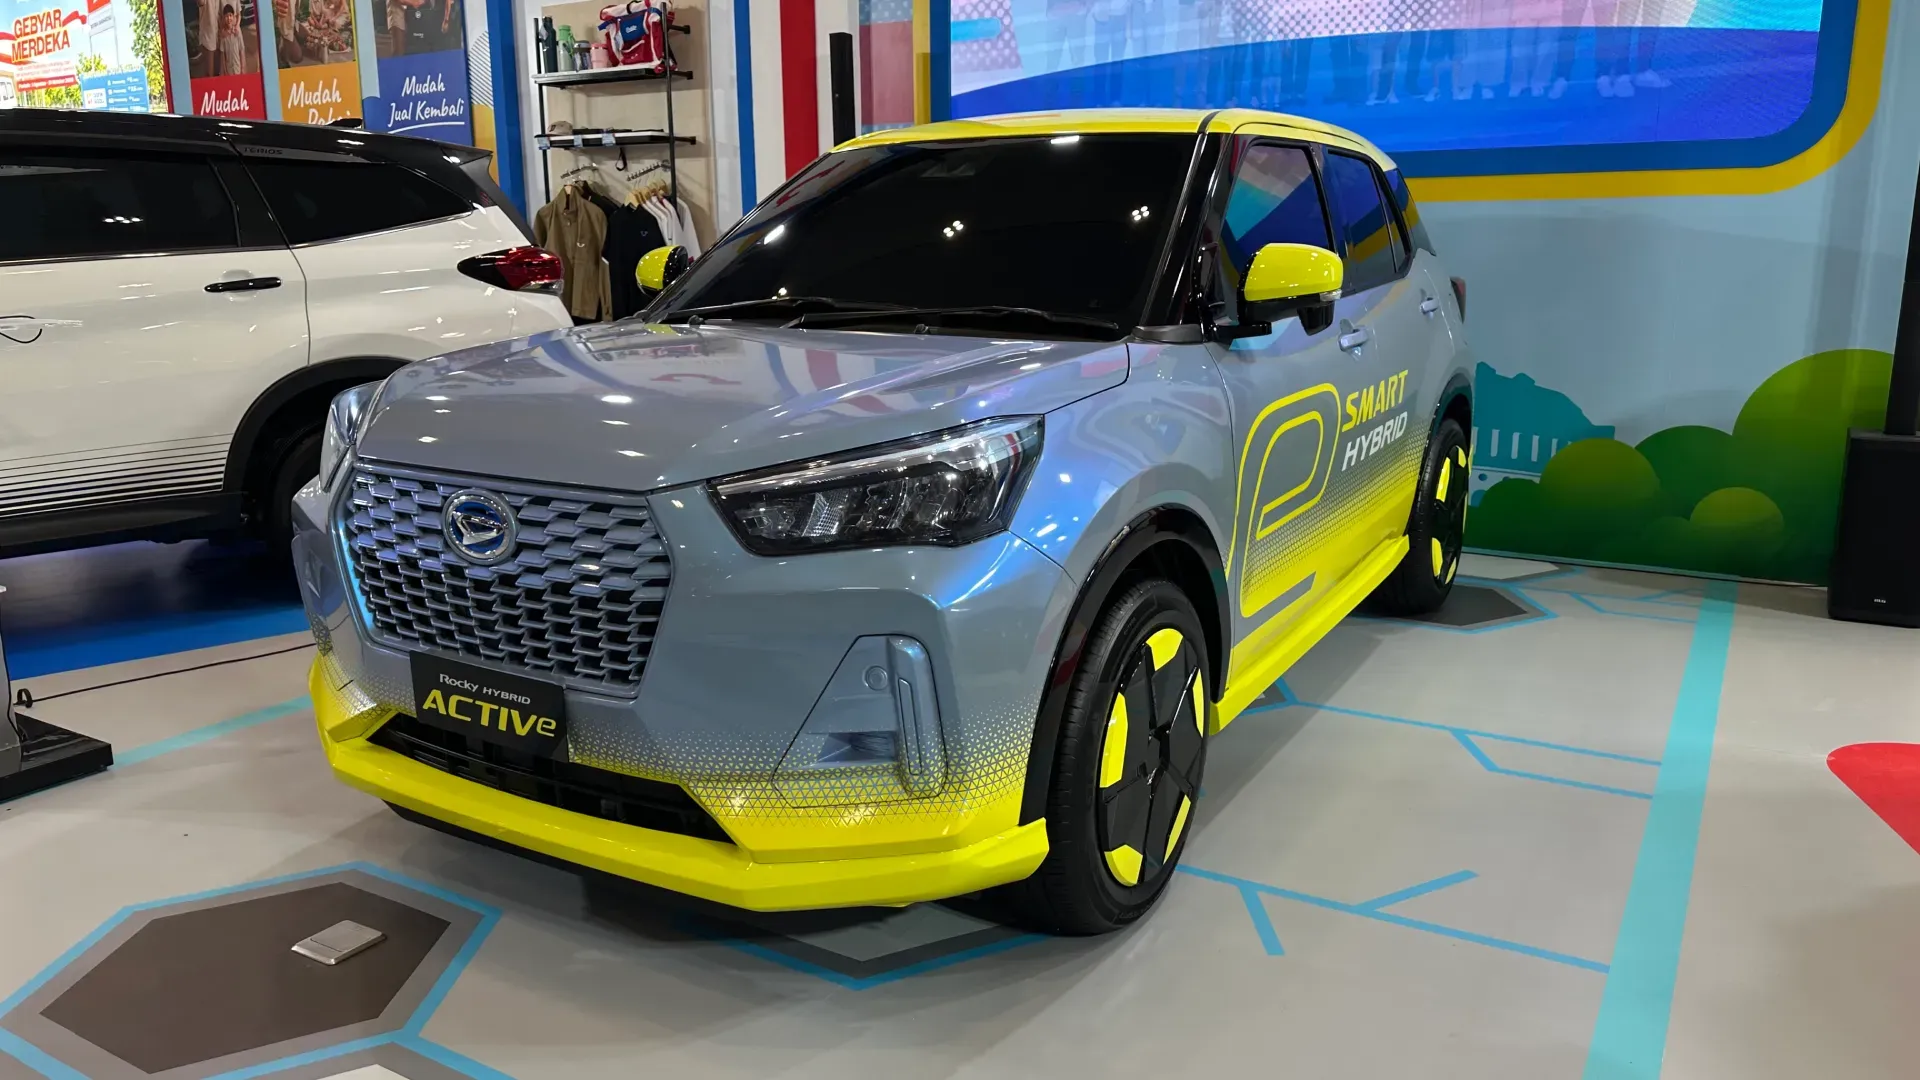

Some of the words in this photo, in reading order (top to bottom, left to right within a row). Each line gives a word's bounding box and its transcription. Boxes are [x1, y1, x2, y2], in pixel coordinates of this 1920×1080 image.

[14, 9, 61, 38] GEBYAR
[12, 30, 70, 61] MERDEKA
[288, 78, 342, 109] Mudah
[401, 72, 446, 97] Mudah
[201, 88, 249, 115] Mudah
[387, 101, 413, 128] Jual
[415, 97, 465, 121] Kembali
[1341, 369, 1408, 432] SMART
[1341, 411, 1408, 472] HYBRID
[482, 686, 531, 705] HYBRID
